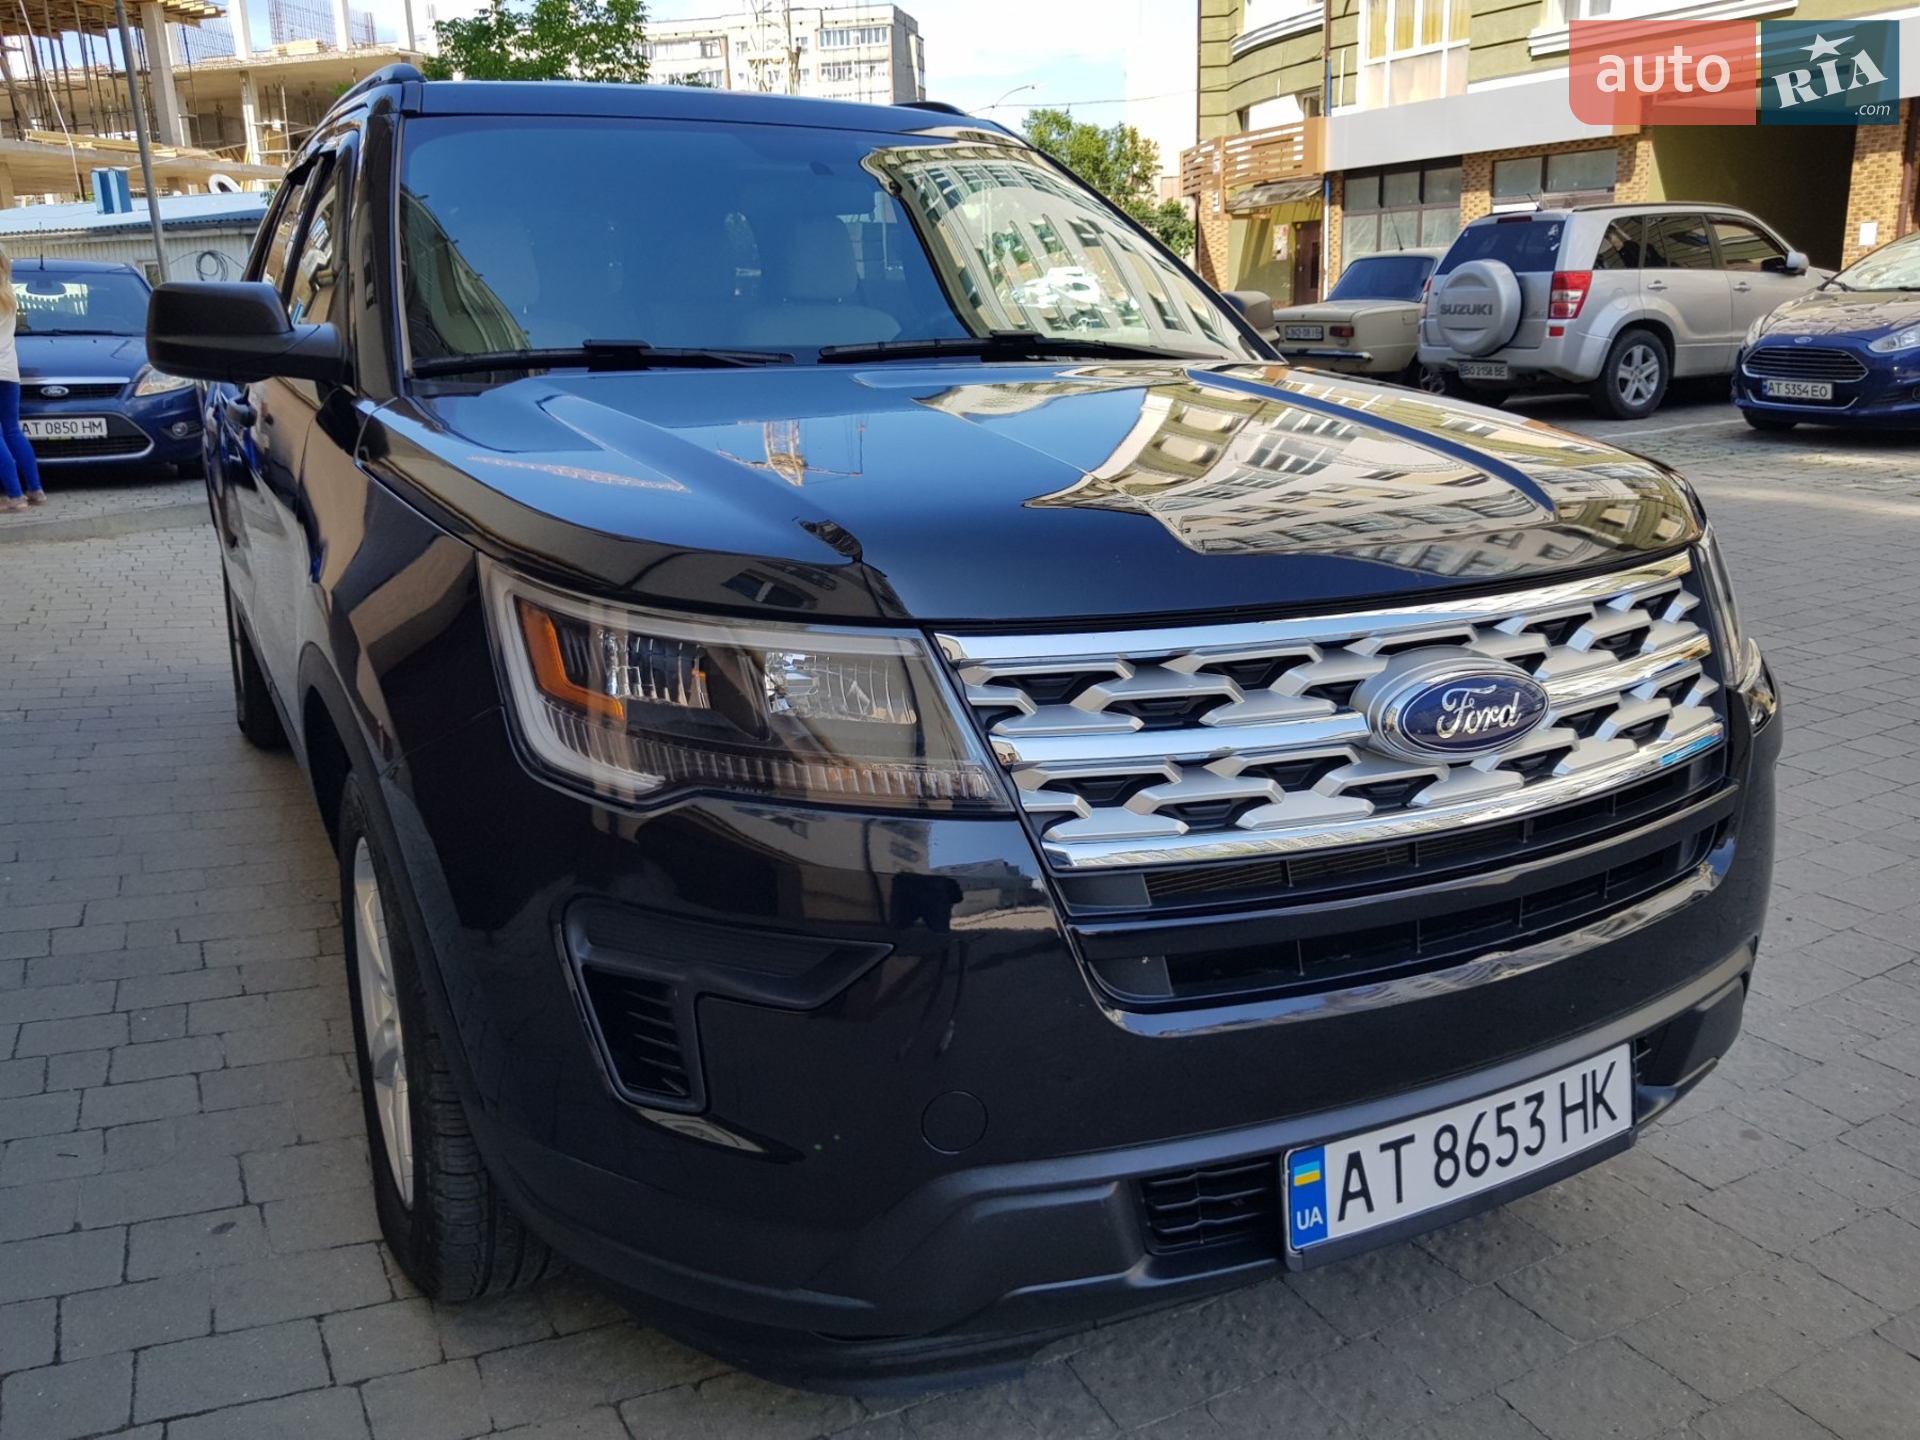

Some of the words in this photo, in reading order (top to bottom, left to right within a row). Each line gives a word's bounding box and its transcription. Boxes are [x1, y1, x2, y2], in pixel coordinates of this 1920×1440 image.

[1440, 303, 1493, 315] SUZUKI
[1768, 381, 1783, 395] AT
[22, 422, 41, 436] AT
[45, 421, 78, 435] 0850
[82, 420, 103, 434] HM
[1436, 684, 1522, 739] Ford
[1337, 1133, 1416, 1222] AT
[1433, 1090, 1546, 1189] 8653
[1559, 1060, 1618, 1144] HK
[1296, 1206, 1324, 1230] UA
